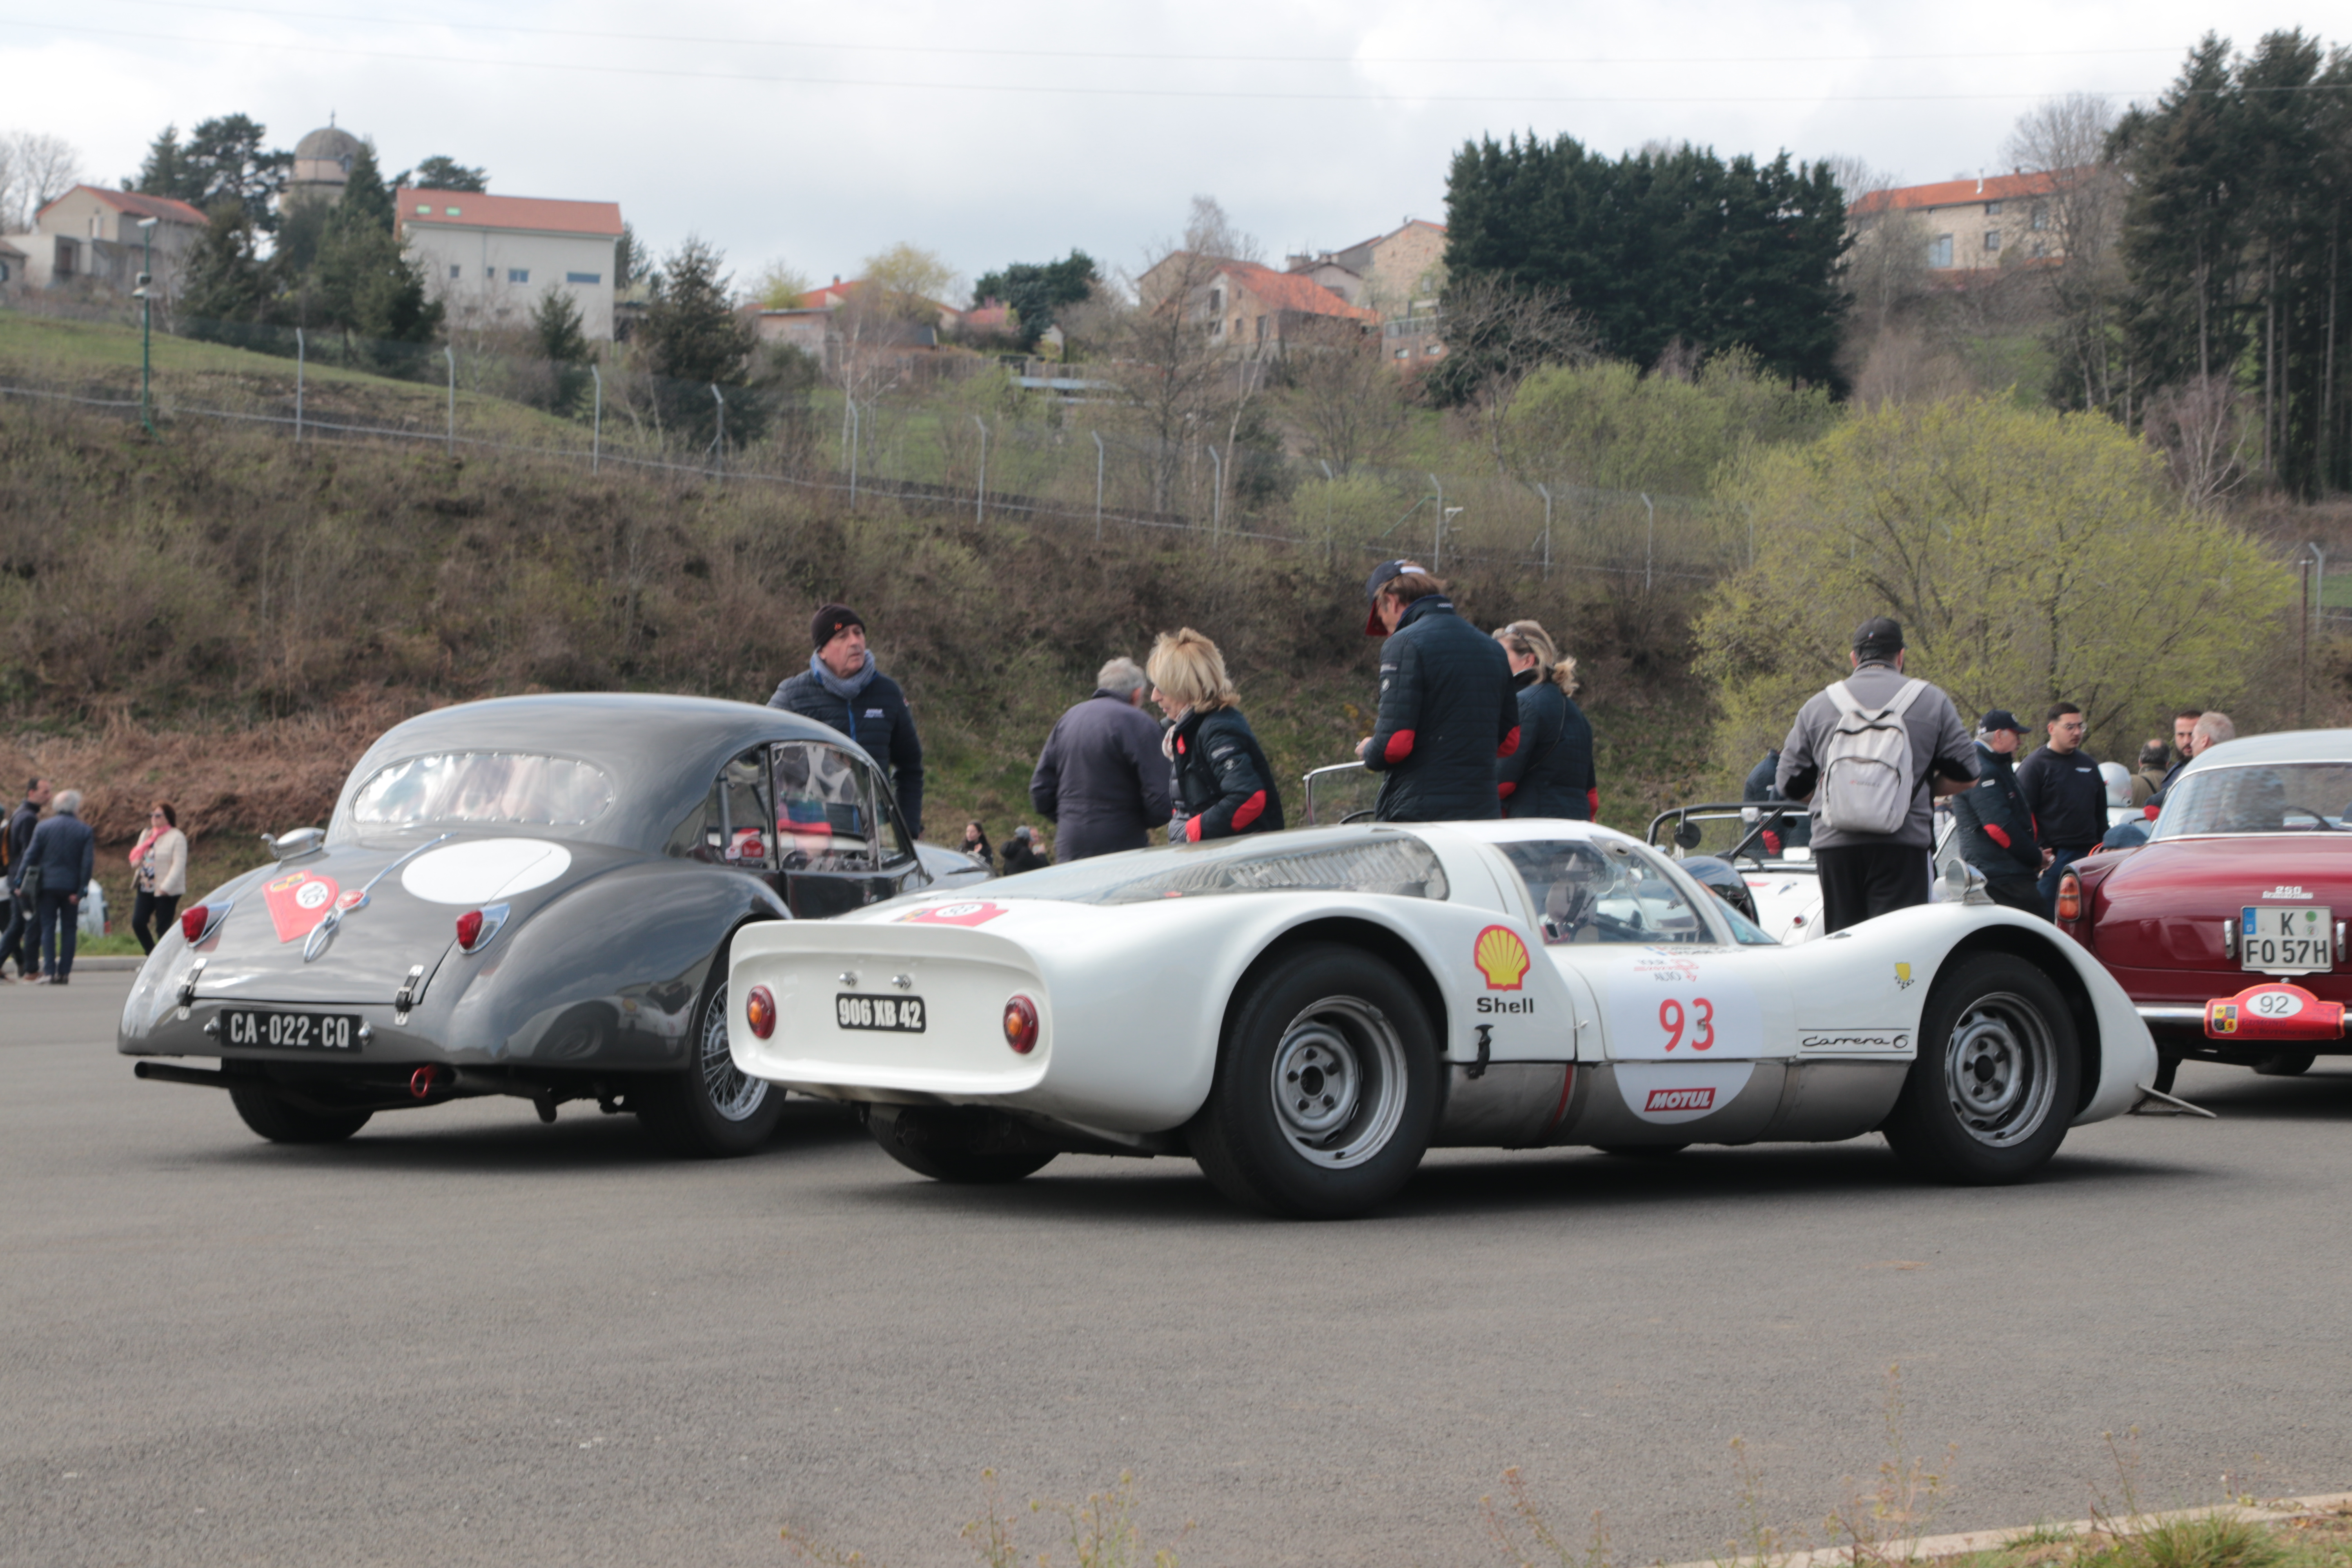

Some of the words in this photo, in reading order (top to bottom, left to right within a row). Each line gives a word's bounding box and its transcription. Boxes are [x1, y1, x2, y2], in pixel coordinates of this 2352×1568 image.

[2275, 886, 2302, 894] 250
[2281, 912, 2294, 936] K
[2246, 939, 2275, 963] FO
[2283, 940, 2328, 964] 57H
[1654, 971, 1681, 981] AUTO
[838, 998, 872, 1026] 906
[873, 999, 897, 1027] XB
[899, 1000, 922, 1028] 42
[1476, 997, 1534, 1013] Shell
[2260, 995, 2288, 1014] 92
[230, 1012, 349, 1048] CA-022-CQ
[1659, 997, 1714, 1053] 93
[1802, 1035, 1891, 1047] Carrera
[1893, 1034, 1909, 1048] 6
[1648, 1090, 1711, 1109] MOTUL
